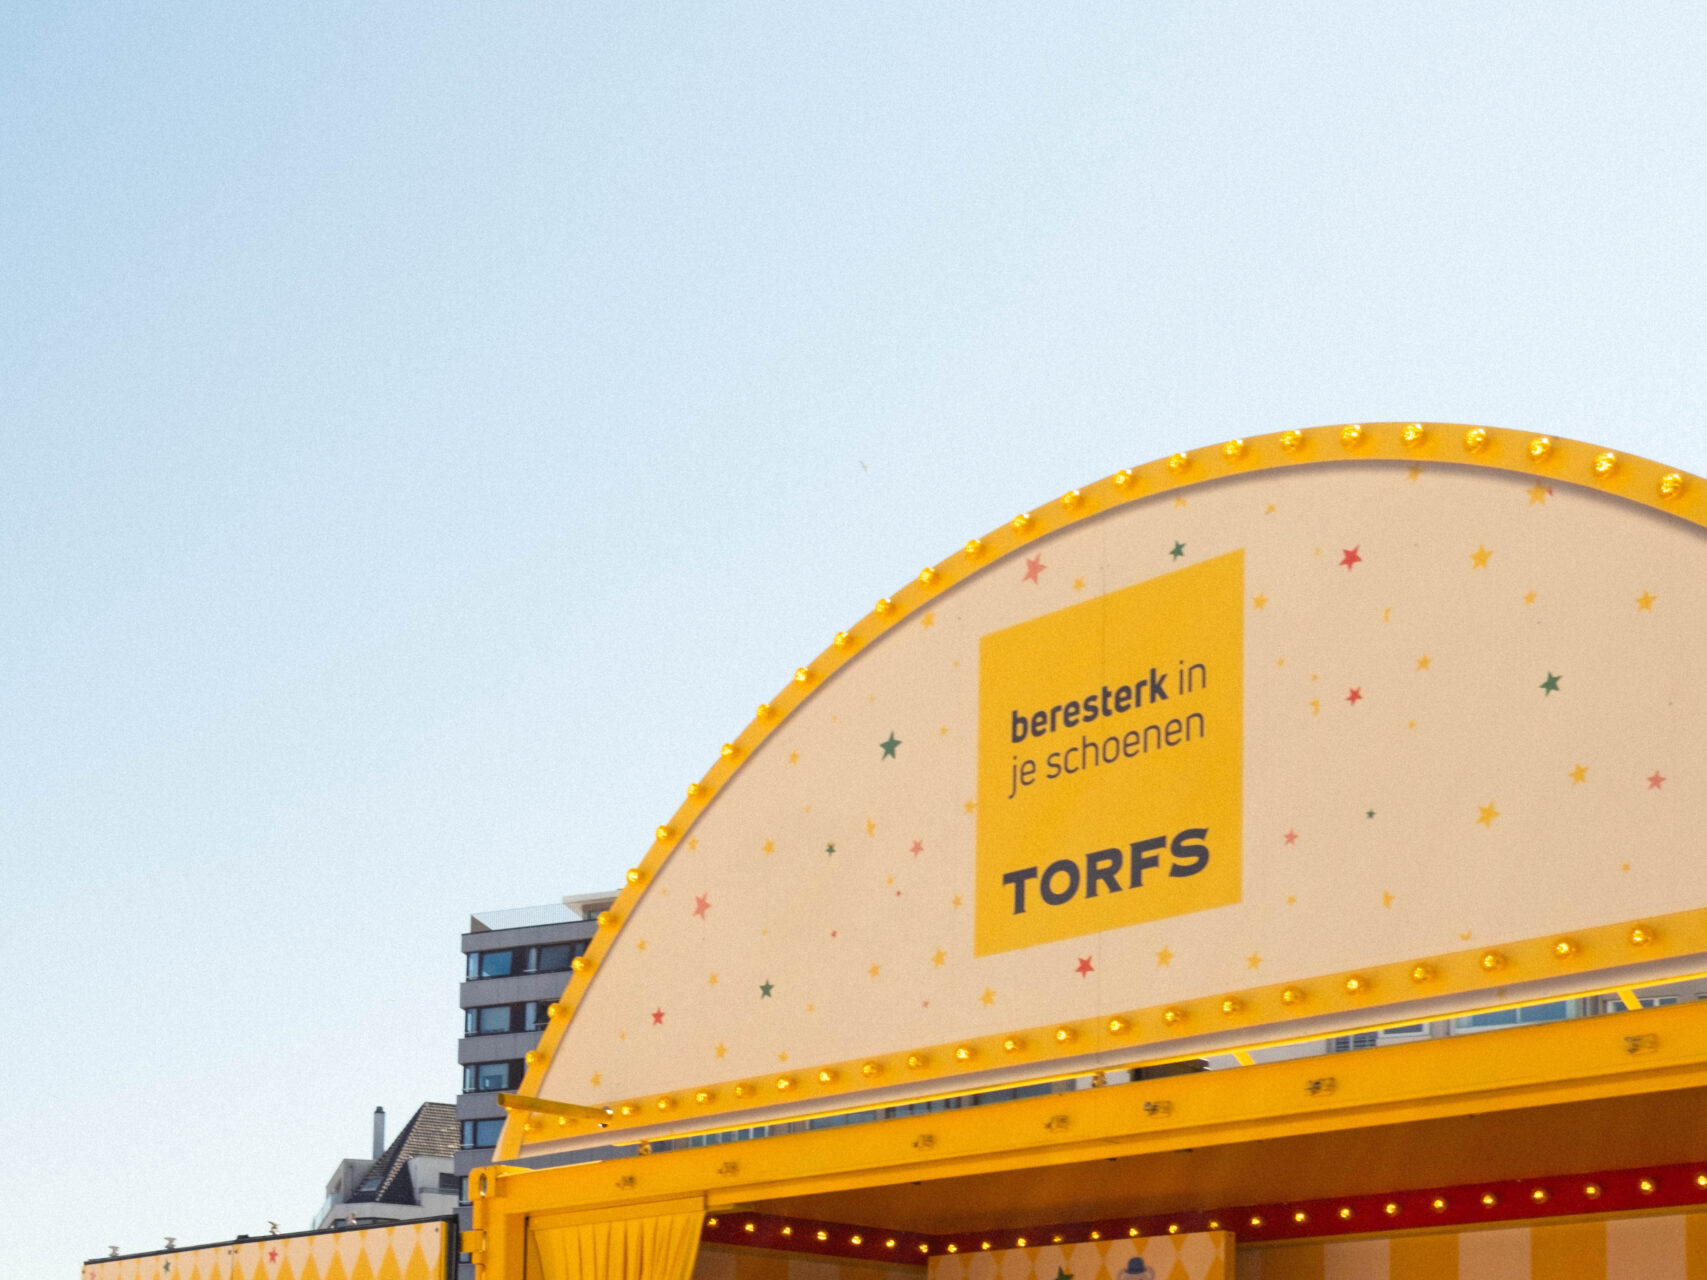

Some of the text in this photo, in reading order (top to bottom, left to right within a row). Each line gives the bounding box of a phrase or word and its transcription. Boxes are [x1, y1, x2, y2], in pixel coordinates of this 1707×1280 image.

[1011, 660, 1207, 743] beresterk in
[1008, 712, 1205, 799] je schoenen
[1002, 828, 1210, 915] TORFS
